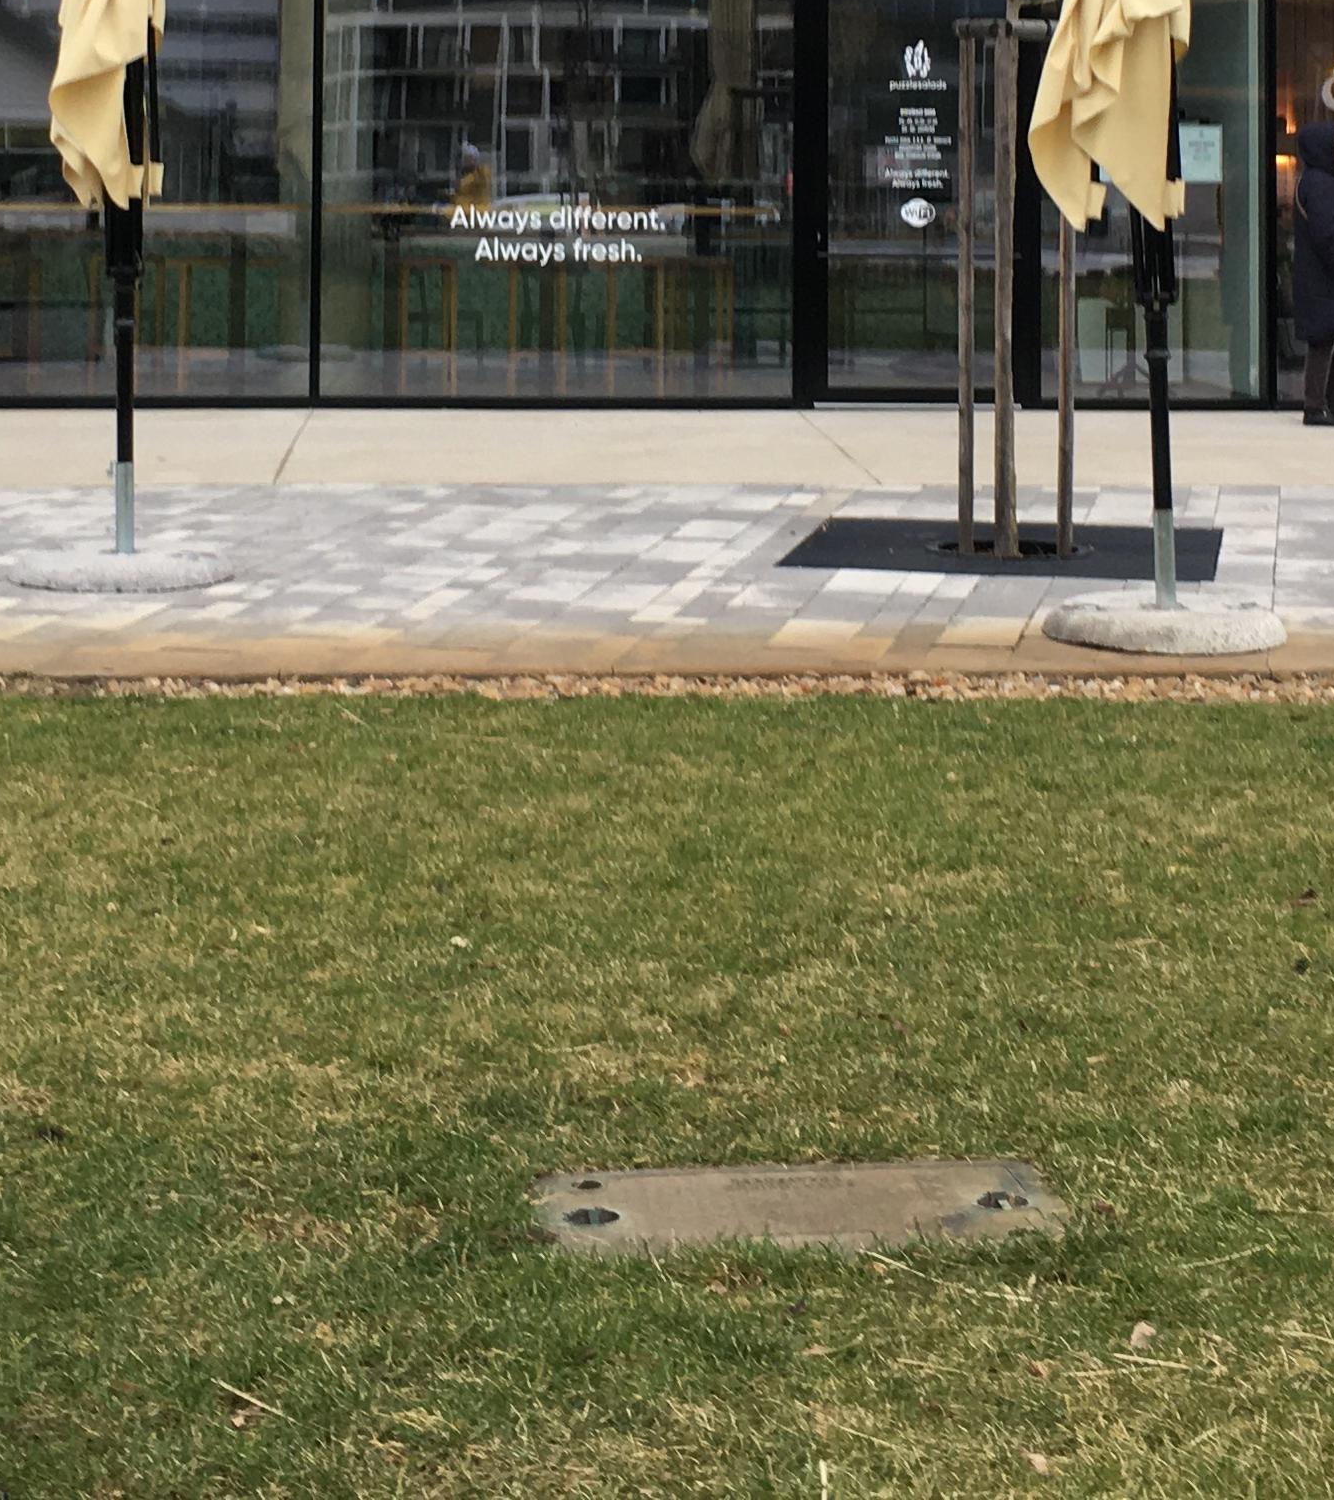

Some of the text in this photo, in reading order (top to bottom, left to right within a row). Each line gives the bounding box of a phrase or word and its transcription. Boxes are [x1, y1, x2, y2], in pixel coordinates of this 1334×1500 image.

[450, 204, 666, 235] Always different.
[475, 236, 643, 267] Always fresh.
